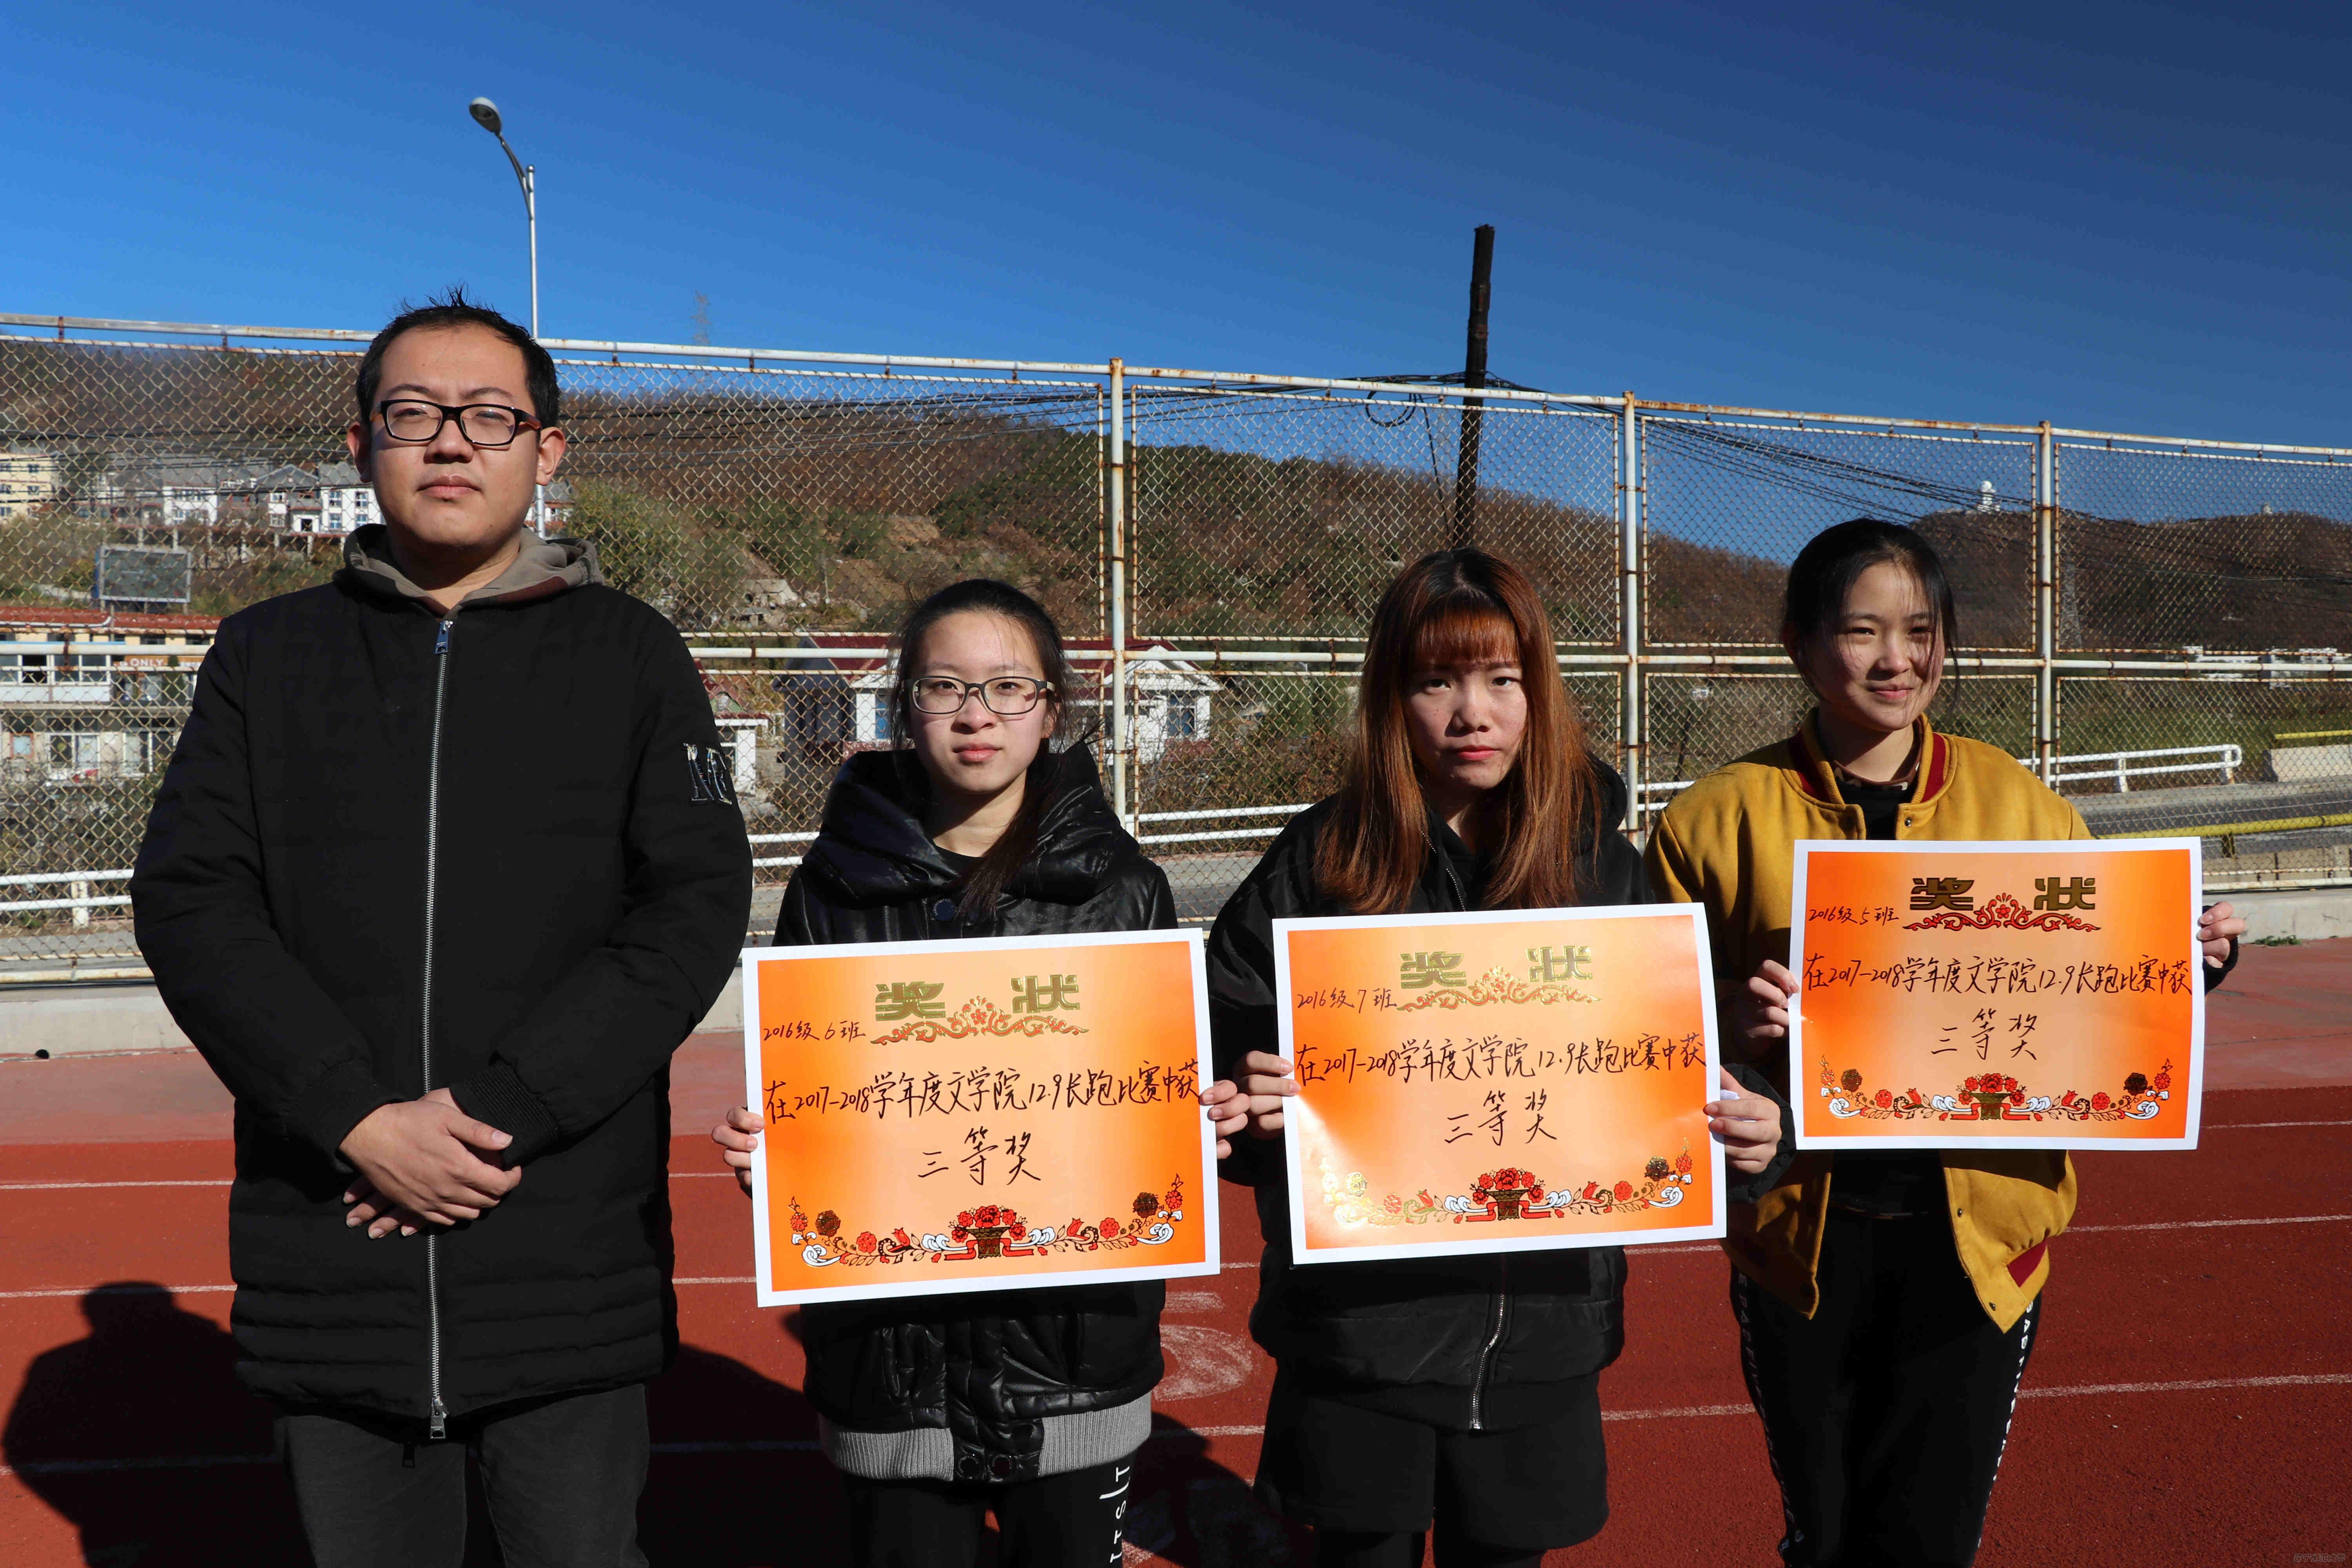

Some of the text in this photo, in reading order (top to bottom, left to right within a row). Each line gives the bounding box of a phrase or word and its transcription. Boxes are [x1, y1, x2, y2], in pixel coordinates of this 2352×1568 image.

[130, 658, 164, 666] ONLY
[1910, 877, 2096, 911] 奖状
[1400, 945, 1593, 989] 奖状
[876, 975, 1080, 1021] 奖状
[1931, 1008, 2037, 1060] 三等奖
[1445, 1088, 1557, 1146] 三等奖
[918, 1126, 1041, 1185] 三等奖
